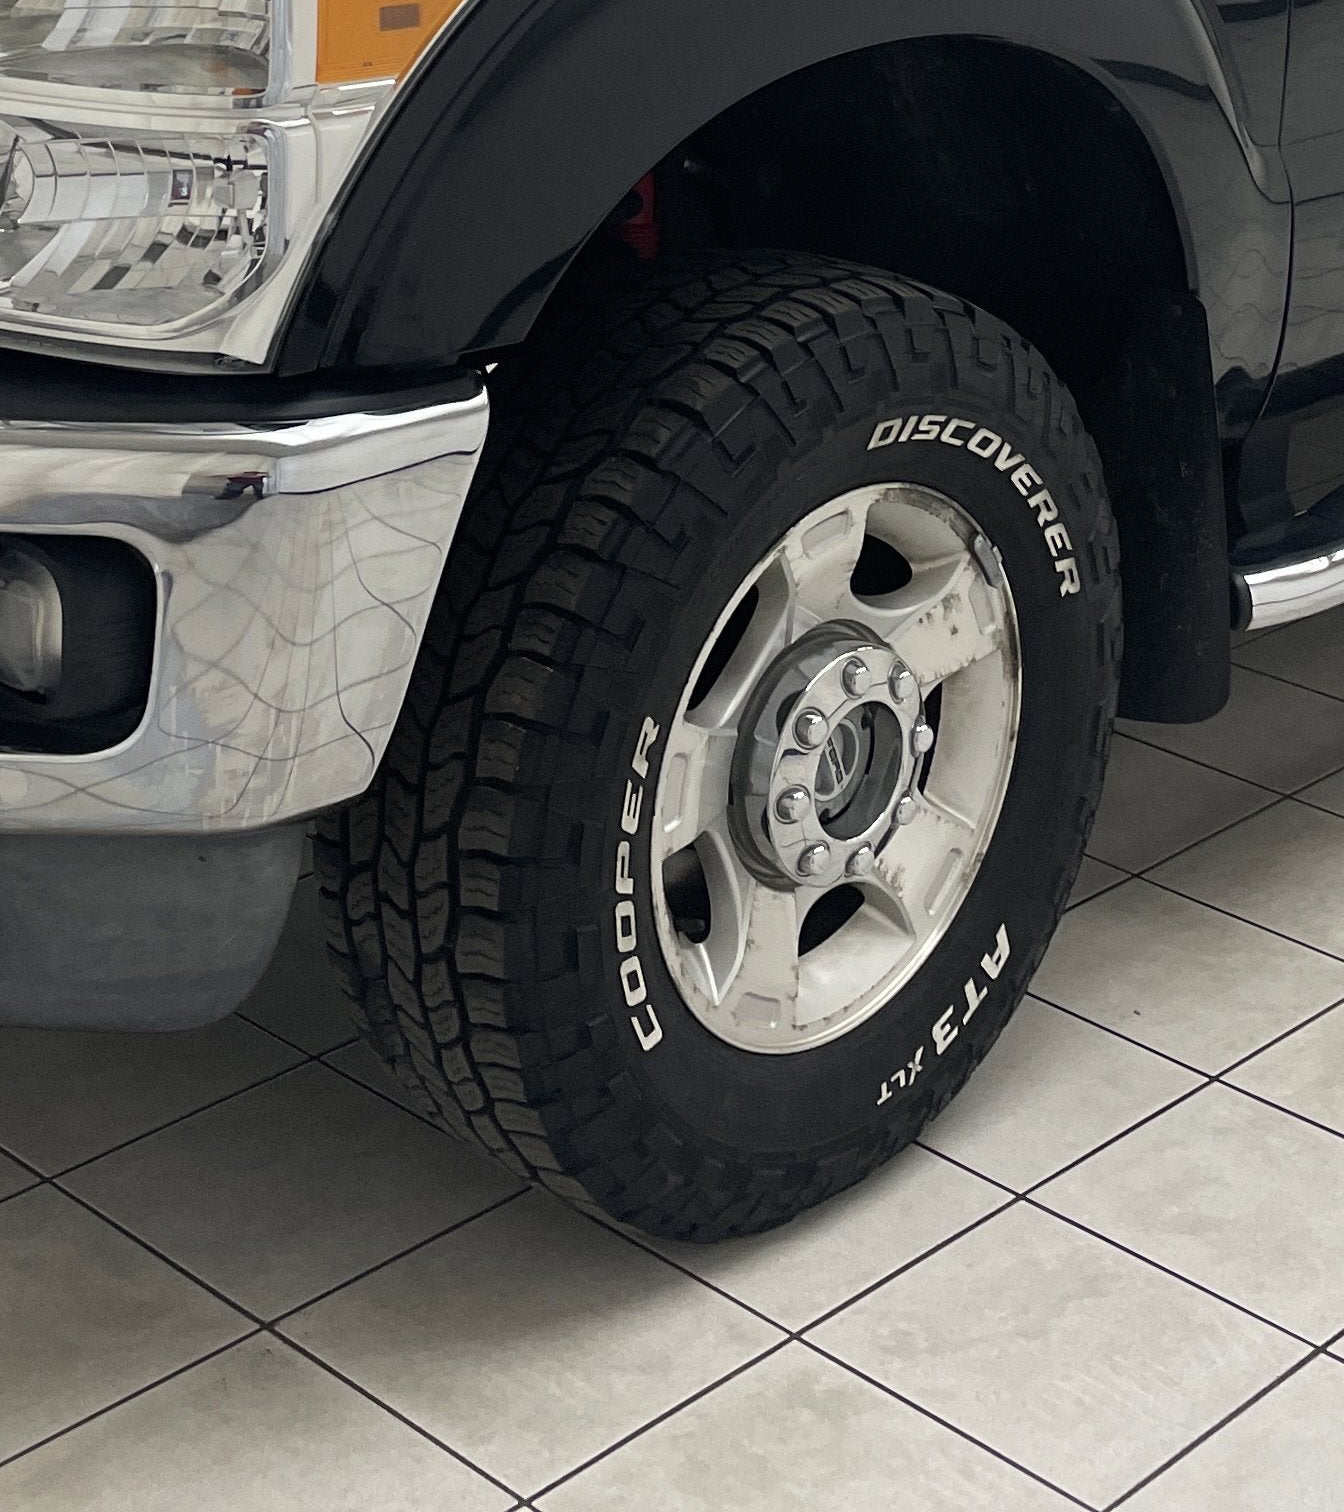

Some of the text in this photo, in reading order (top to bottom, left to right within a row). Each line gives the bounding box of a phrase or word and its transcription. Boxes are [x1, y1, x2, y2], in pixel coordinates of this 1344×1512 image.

[866, 414, 1081, 598] DISCOVERER
[615, 716, 660, 1052] COOPER
[876, 922, 1011, 1106] AT3 XLT
